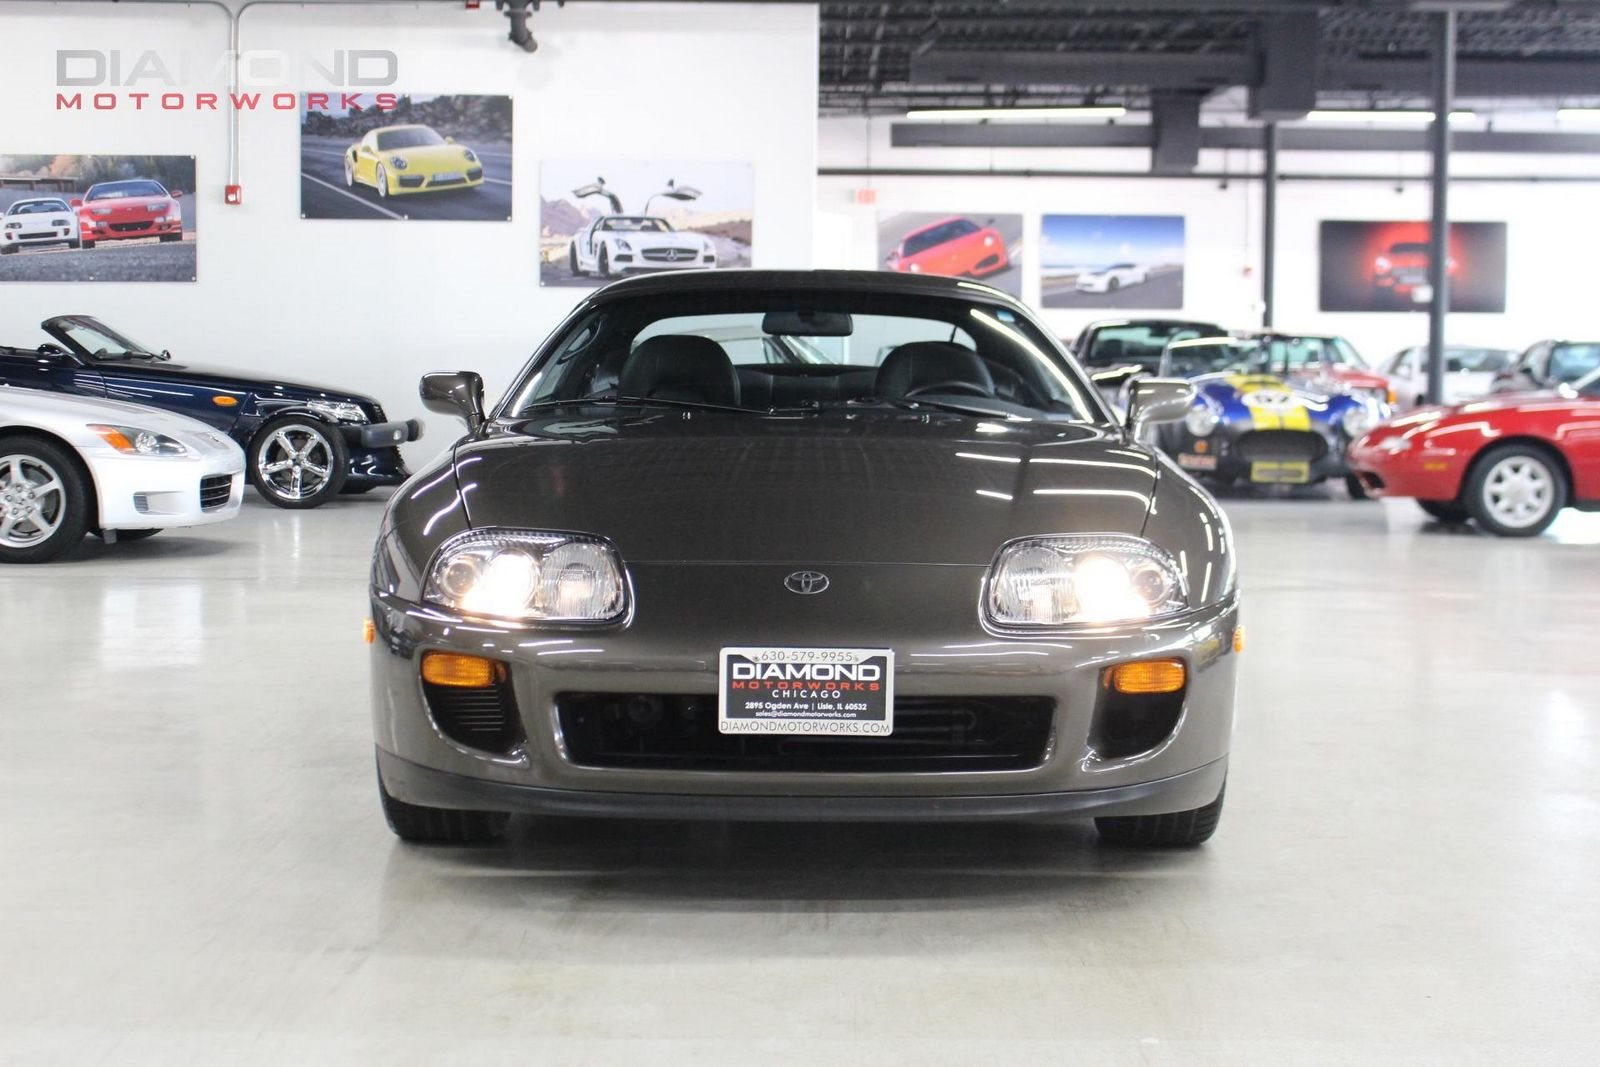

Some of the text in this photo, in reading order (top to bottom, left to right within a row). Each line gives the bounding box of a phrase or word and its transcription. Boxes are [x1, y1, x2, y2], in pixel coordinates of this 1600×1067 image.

[761, 650, 853, 662] 630-579-9955
[732, 663, 881, 681] DIAMOND
[732, 681, 880, 691] MOTORWORKS
[772, 689, 841, 699] CHICAGO
[745, 701, 763, 710] 2895
[765, 702, 792, 711] Ogden
[793, 702, 809, 710] Ave
[845, 703, 868, 711] 60532
[755, 710, 857, 718] sales@diamondmotorworks.com
[721, 721, 890, 733] DIAMONDMOTORWORKS.COM
